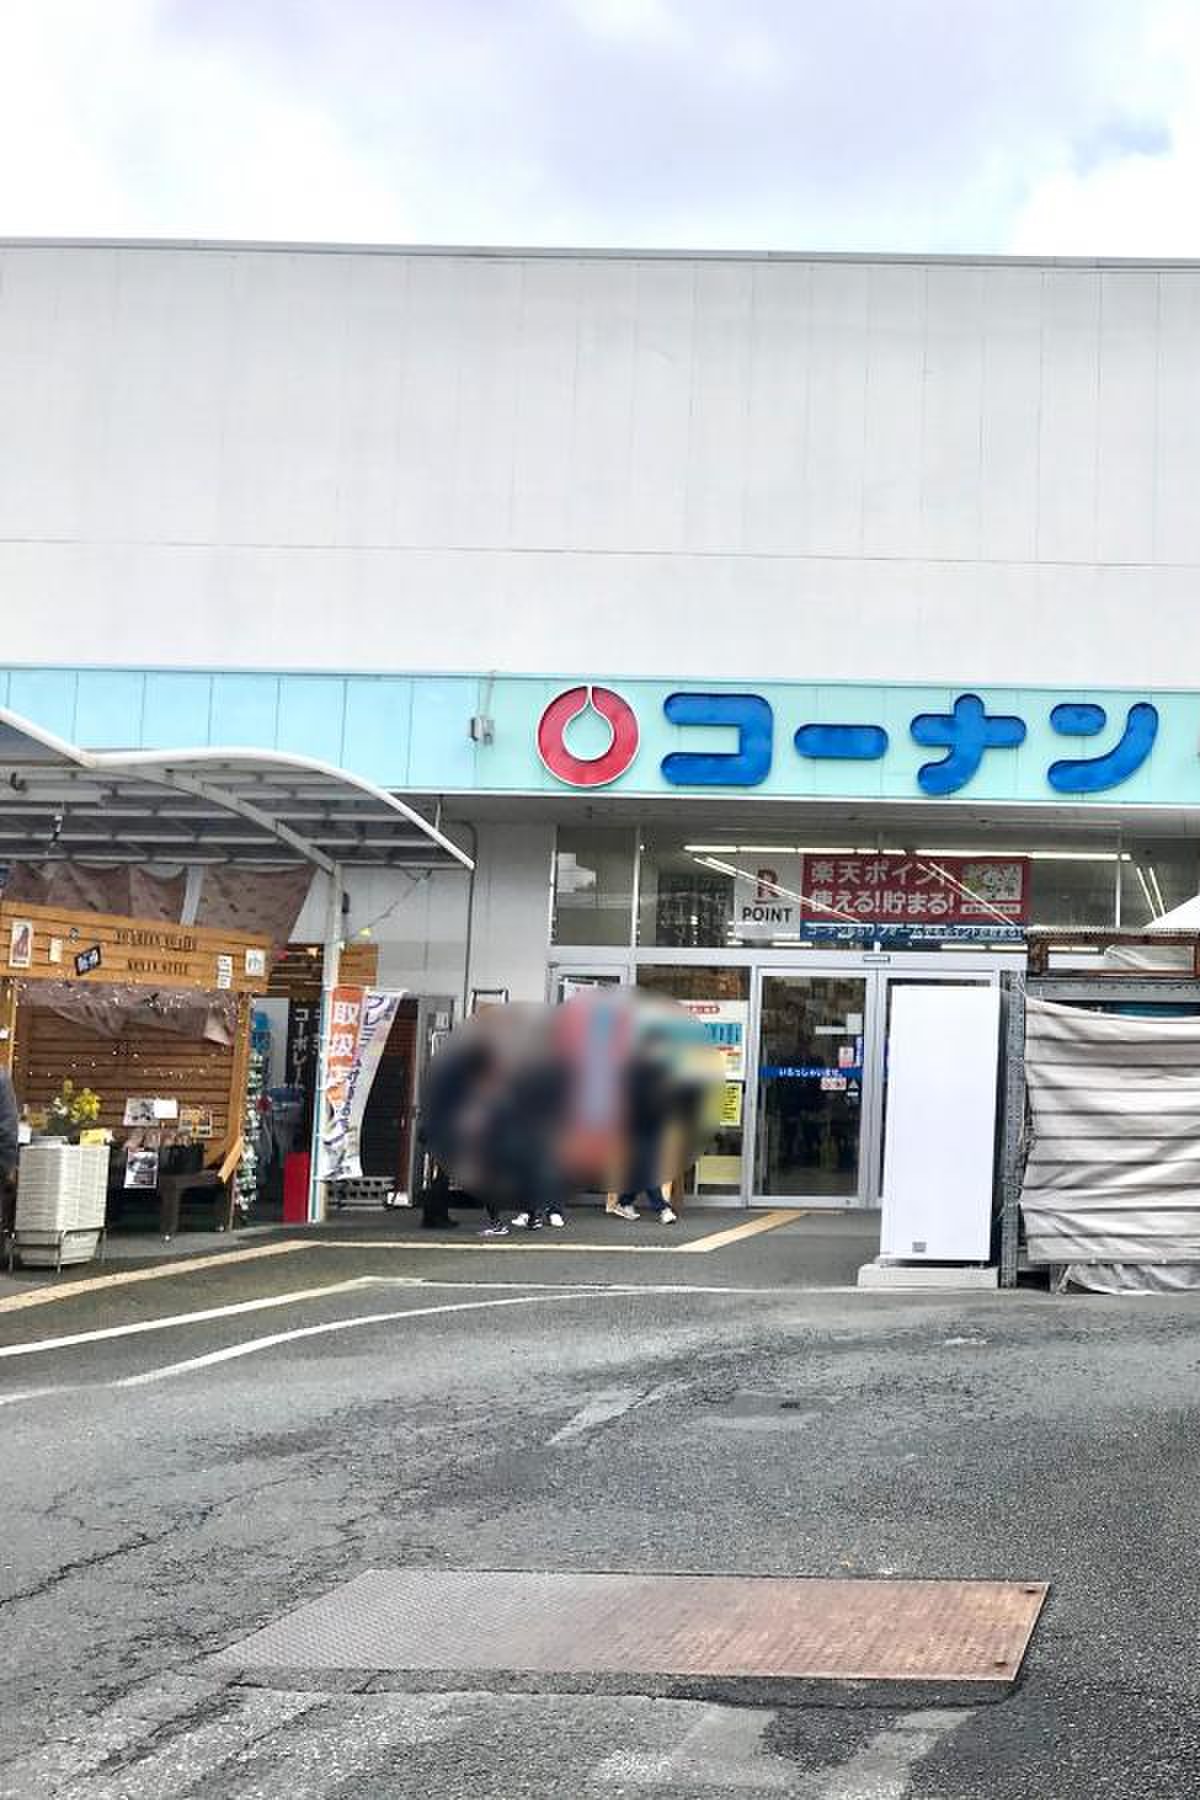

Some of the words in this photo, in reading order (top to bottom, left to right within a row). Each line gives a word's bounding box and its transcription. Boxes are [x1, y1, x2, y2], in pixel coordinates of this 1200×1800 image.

[660, 692, 1159, 795] コーナン
[810, 861, 946, 885] 楽天ポイント
[741, 906, 793, 923] POINT
